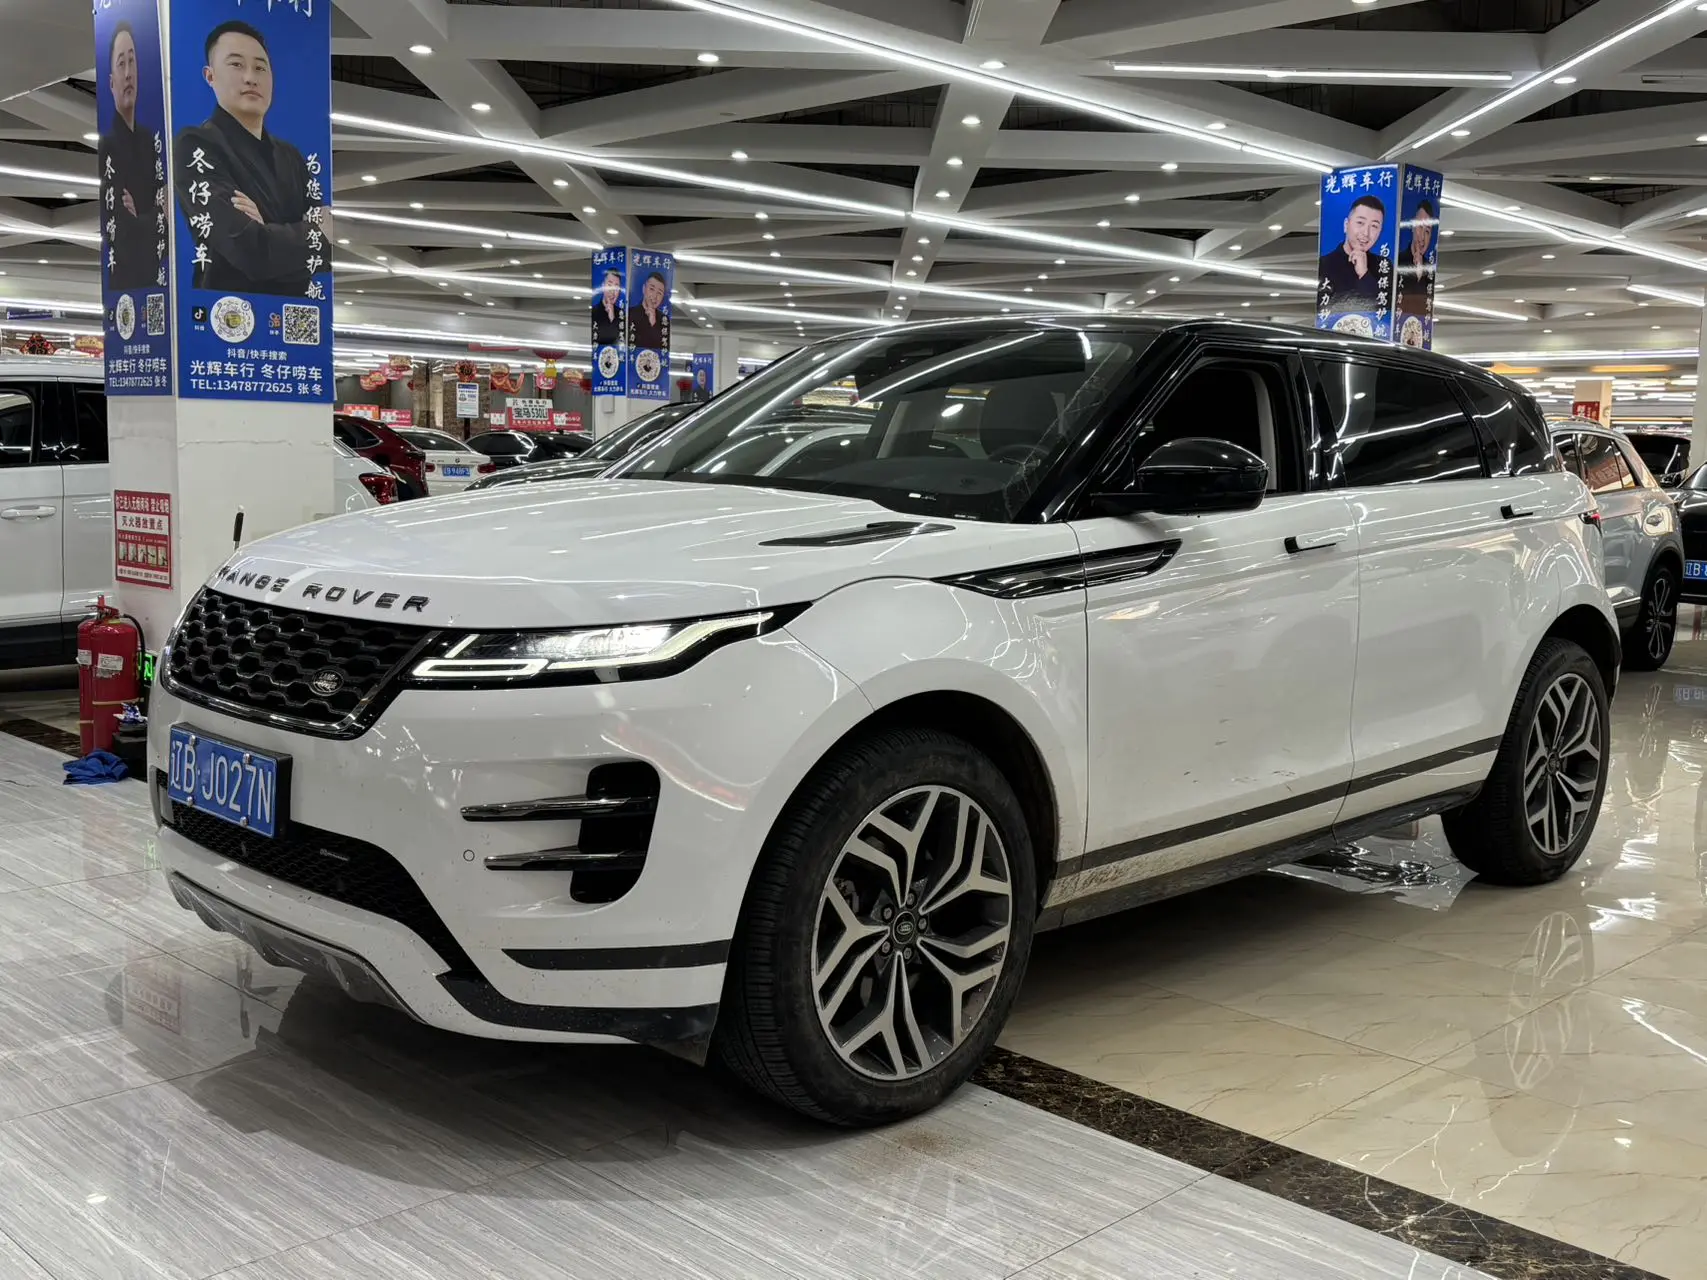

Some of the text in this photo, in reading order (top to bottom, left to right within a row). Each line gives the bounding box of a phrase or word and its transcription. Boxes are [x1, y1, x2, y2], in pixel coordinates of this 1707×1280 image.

[1324, 172, 1393, 194] 光辉车行
[1405, 171, 1440, 196] 光辉车行
[186, 147, 214, 272] 冬仔唠车
[305, 154, 326, 300] 为您保驾护航
[1374, 243, 1391, 337] 为您保驾护航
[227, 348, 288, 361] 抖音/快手搜索
[190, 360, 322, 380] 光辉车行 冬仔唠车
[190, 378, 293, 394] TEL:13478772625
[218, 566, 430, 613] RANGE ROVER
